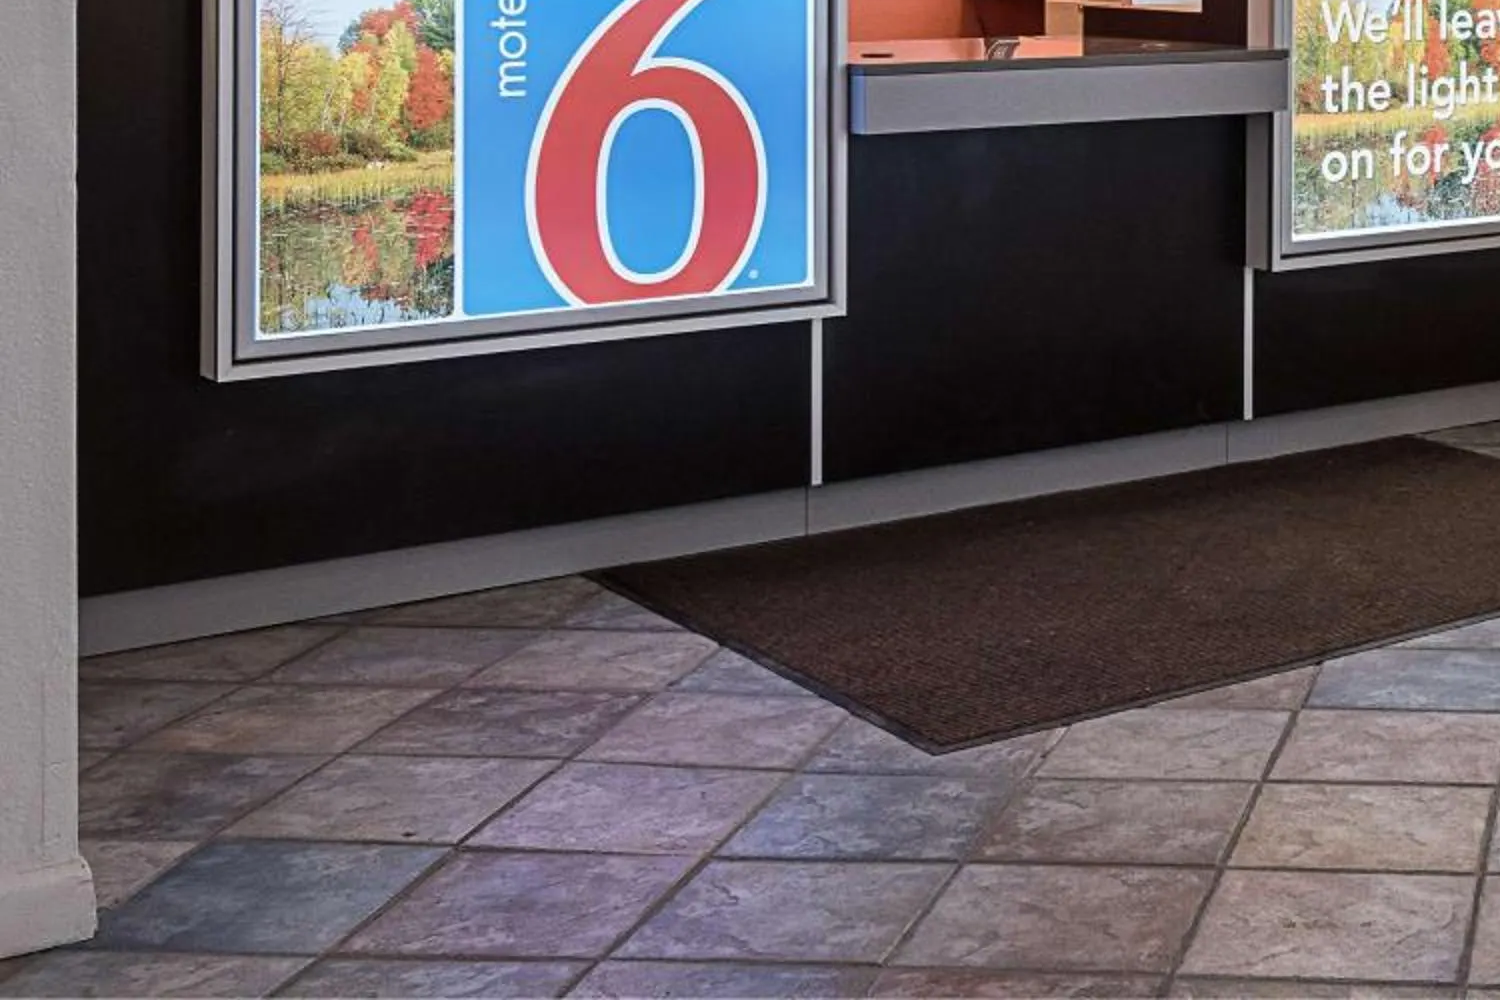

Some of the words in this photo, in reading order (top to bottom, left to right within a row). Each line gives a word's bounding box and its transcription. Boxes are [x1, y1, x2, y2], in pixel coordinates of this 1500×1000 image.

[1321, 66, 1392, 113] the
[1406, 60, 1499, 120] light
[1321, 147, 1373, 182] on
[1390, 131, 1450, 178] for
